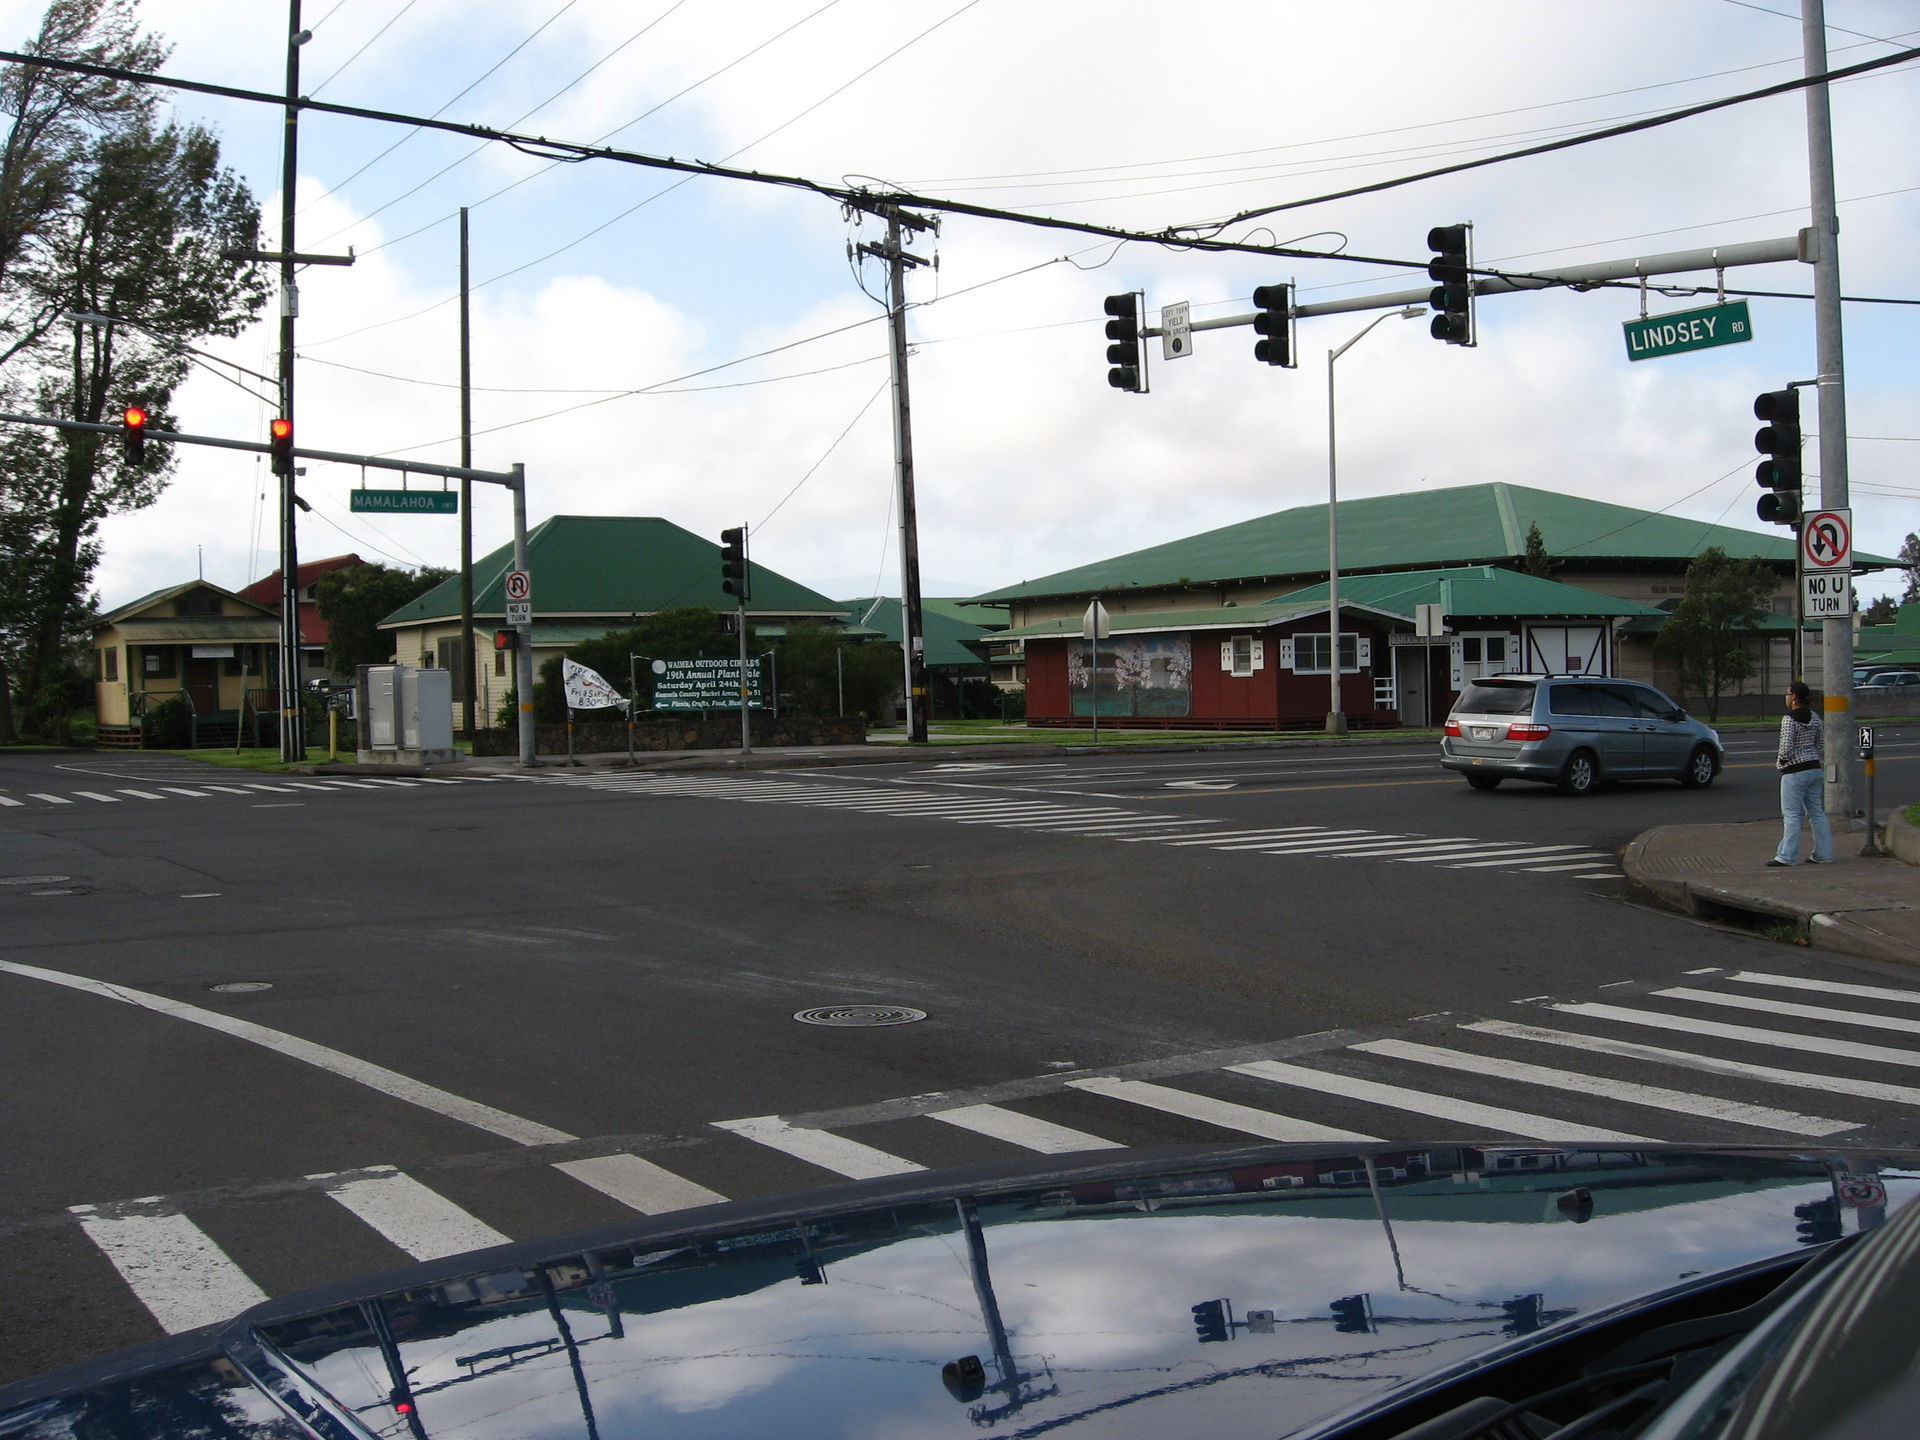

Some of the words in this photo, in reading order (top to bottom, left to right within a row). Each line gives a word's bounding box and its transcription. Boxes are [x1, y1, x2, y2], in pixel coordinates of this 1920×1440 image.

[1168, 316, 1184, 328] YIELD
[1630, 316, 1717, 351] LINDSEY
[1731, 321, 1745, 333] RD
[353, 495, 435, 508] MAMALAHOA
[1808, 578, 1826, 595] NO
[1832, 577, 1843, 593] U
[509, 604, 519, 613] NO
[521, 604, 528, 613] U
[1812, 598, 1840, 612] TURN
[511, 614, 527, 622] TURN
[667, 660, 694, 669] WAIMEA
[695, 659, 729, 668] OUTDOOR
[666, 670, 685, 680] 19th
[686, 669, 716, 679] Annual
[717, 669, 740, 678] Plant
[657, 681, 694, 690] Saturday
[695, 681, 716, 690] April
